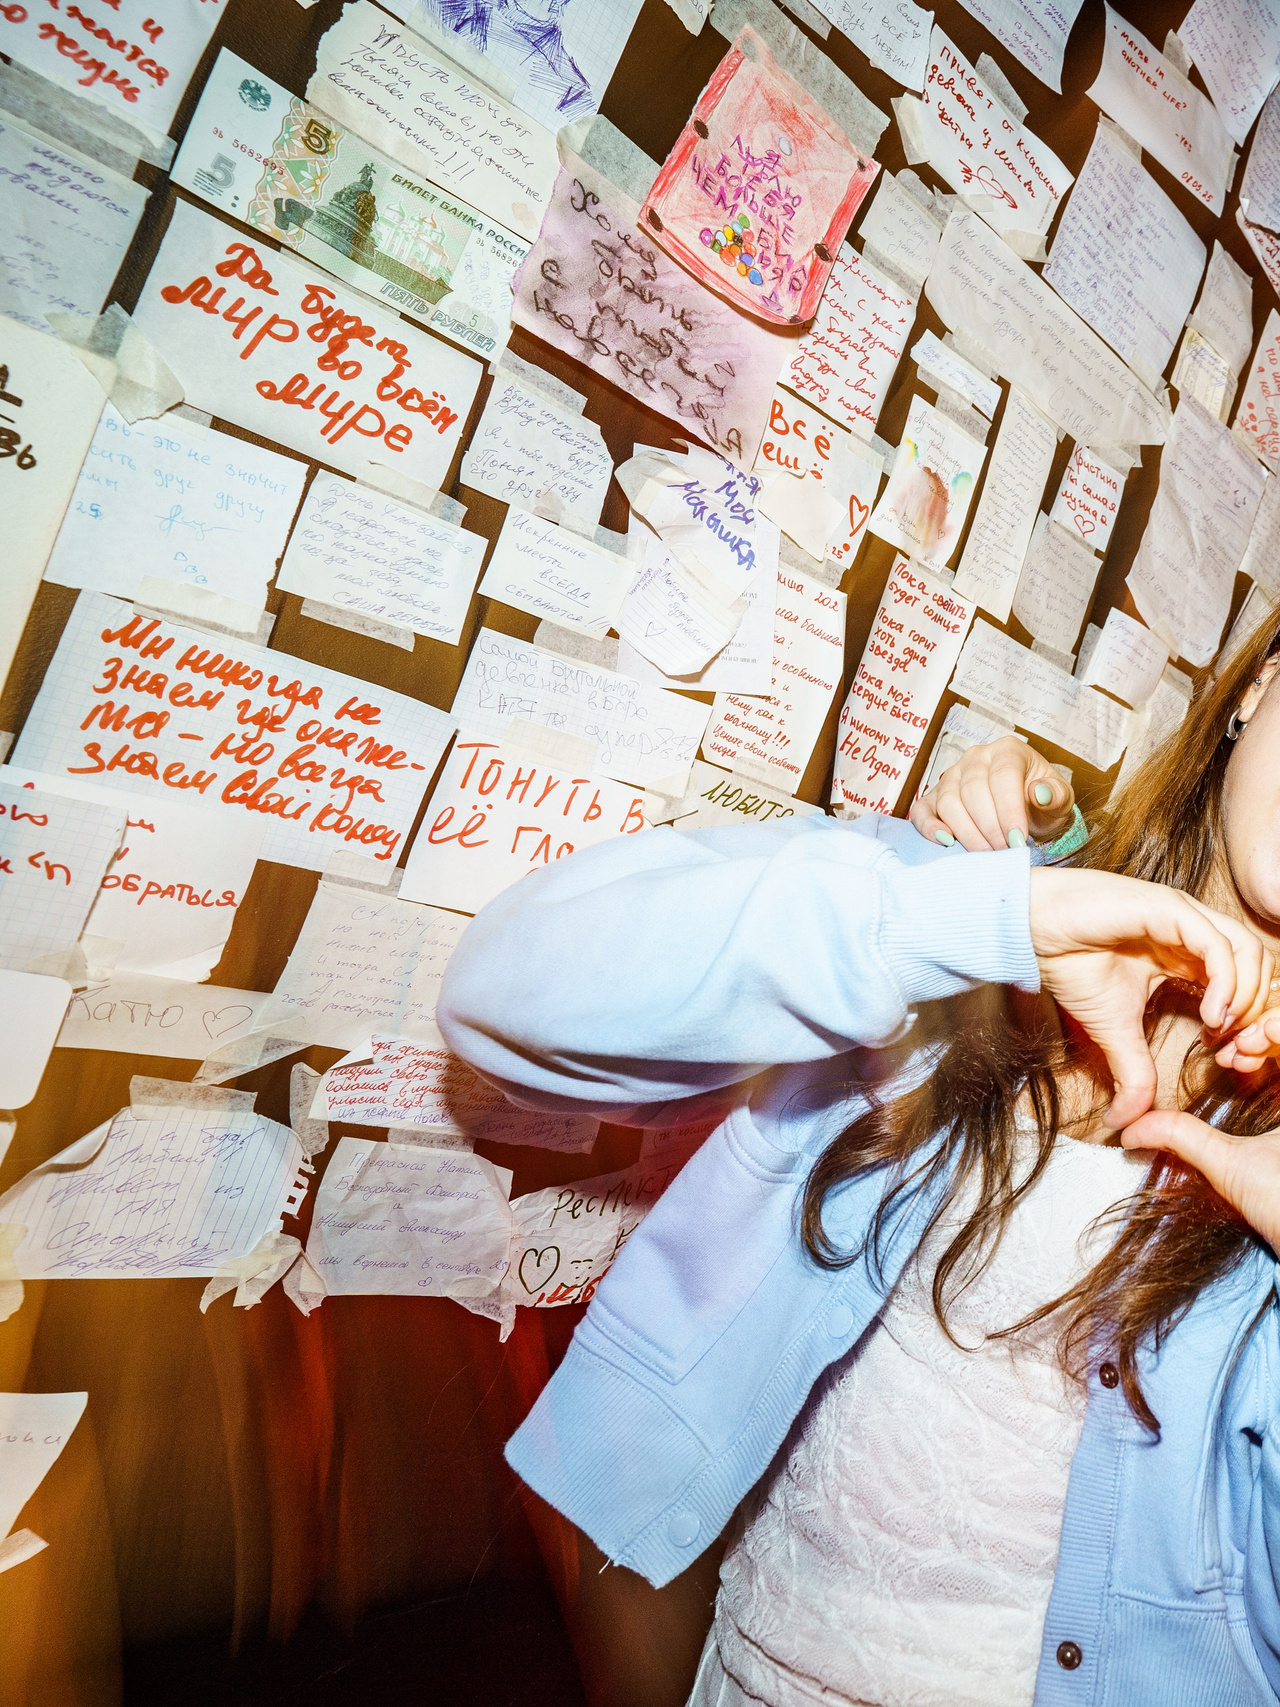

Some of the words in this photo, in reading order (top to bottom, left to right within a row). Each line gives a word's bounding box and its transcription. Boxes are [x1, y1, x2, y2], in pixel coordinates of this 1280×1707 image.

[232, 139, 285, 176] 5682695
[302, 118, 331, 155] 5
[208, 152, 237, 189] 5
[391, 173, 439, 205] БИЛЕТ
[439, 200, 484, 234] БАНКА
[486, 227, 529, 259] РОССИ
[215, 242, 279, 296] Да
[300, 283, 412, 368] будет
[381, 282, 428, 315] ПЯТЬ
[431, 310, 497, 352] РУБЛЕЙ
[770, 399, 834, 460] Всё
[153, 435, 182, 453] это
[188, 450, 211, 466] не
[225, 462, 289, 496] значит
[1073, 442, 1118, 492] Кристина
[154, 467, 195, 493] друг
[213, 491, 265, 523] другу
[1082, 484, 1117, 513] самая
[894, 561, 929, 596] Пока
[878, 606, 904, 634] Пока
[907, 629, 938, 653] горит
[888, 581, 921, 608] будет
[922, 604, 961, 635] солнце
[868, 643, 909, 674] звезда
[874, 625, 896, 648] хоть
[902, 646, 928, 668] одна
[93, 657, 225, 717] знаем
[235, 700, 287, 743] где
[176, 646, 323, 719] никогда
[851, 681, 888, 713] сердце
[857, 663, 883, 692] Пока
[889, 685, 915, 708] моё
[839, 730, 864, 760] Не
[849, 715, 891, 748] никому
[66, 741, 218, 796] знаем
[210, 732, 275, 767] но
[278, 748, 386, 813] всегда
[457, 742, 602, 824] ТОНУТЬ
